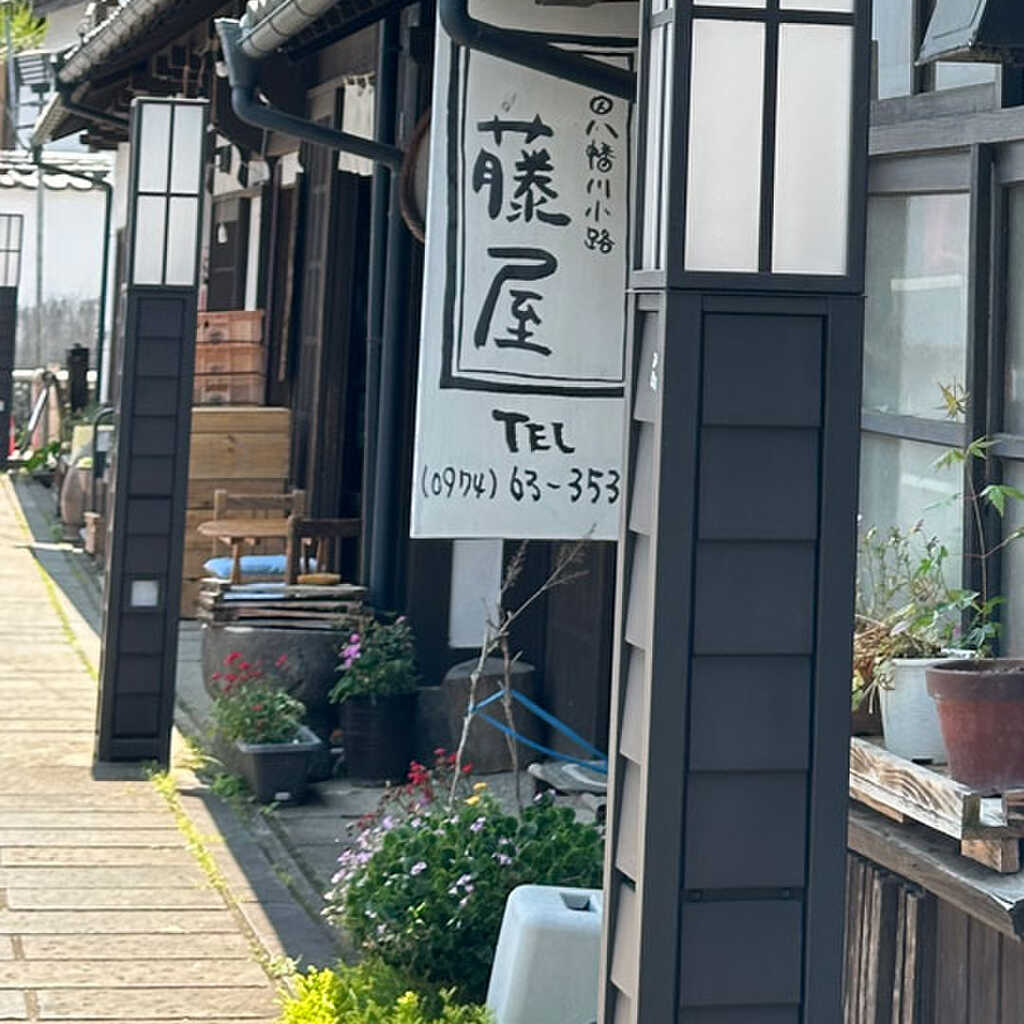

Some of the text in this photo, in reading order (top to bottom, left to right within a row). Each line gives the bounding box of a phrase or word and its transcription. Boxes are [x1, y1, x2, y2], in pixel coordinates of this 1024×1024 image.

[473, 114, 571, 355] 藤屋
[492, 409, 575, 453] TEL
[510, 466, 620, 504] 63-353
